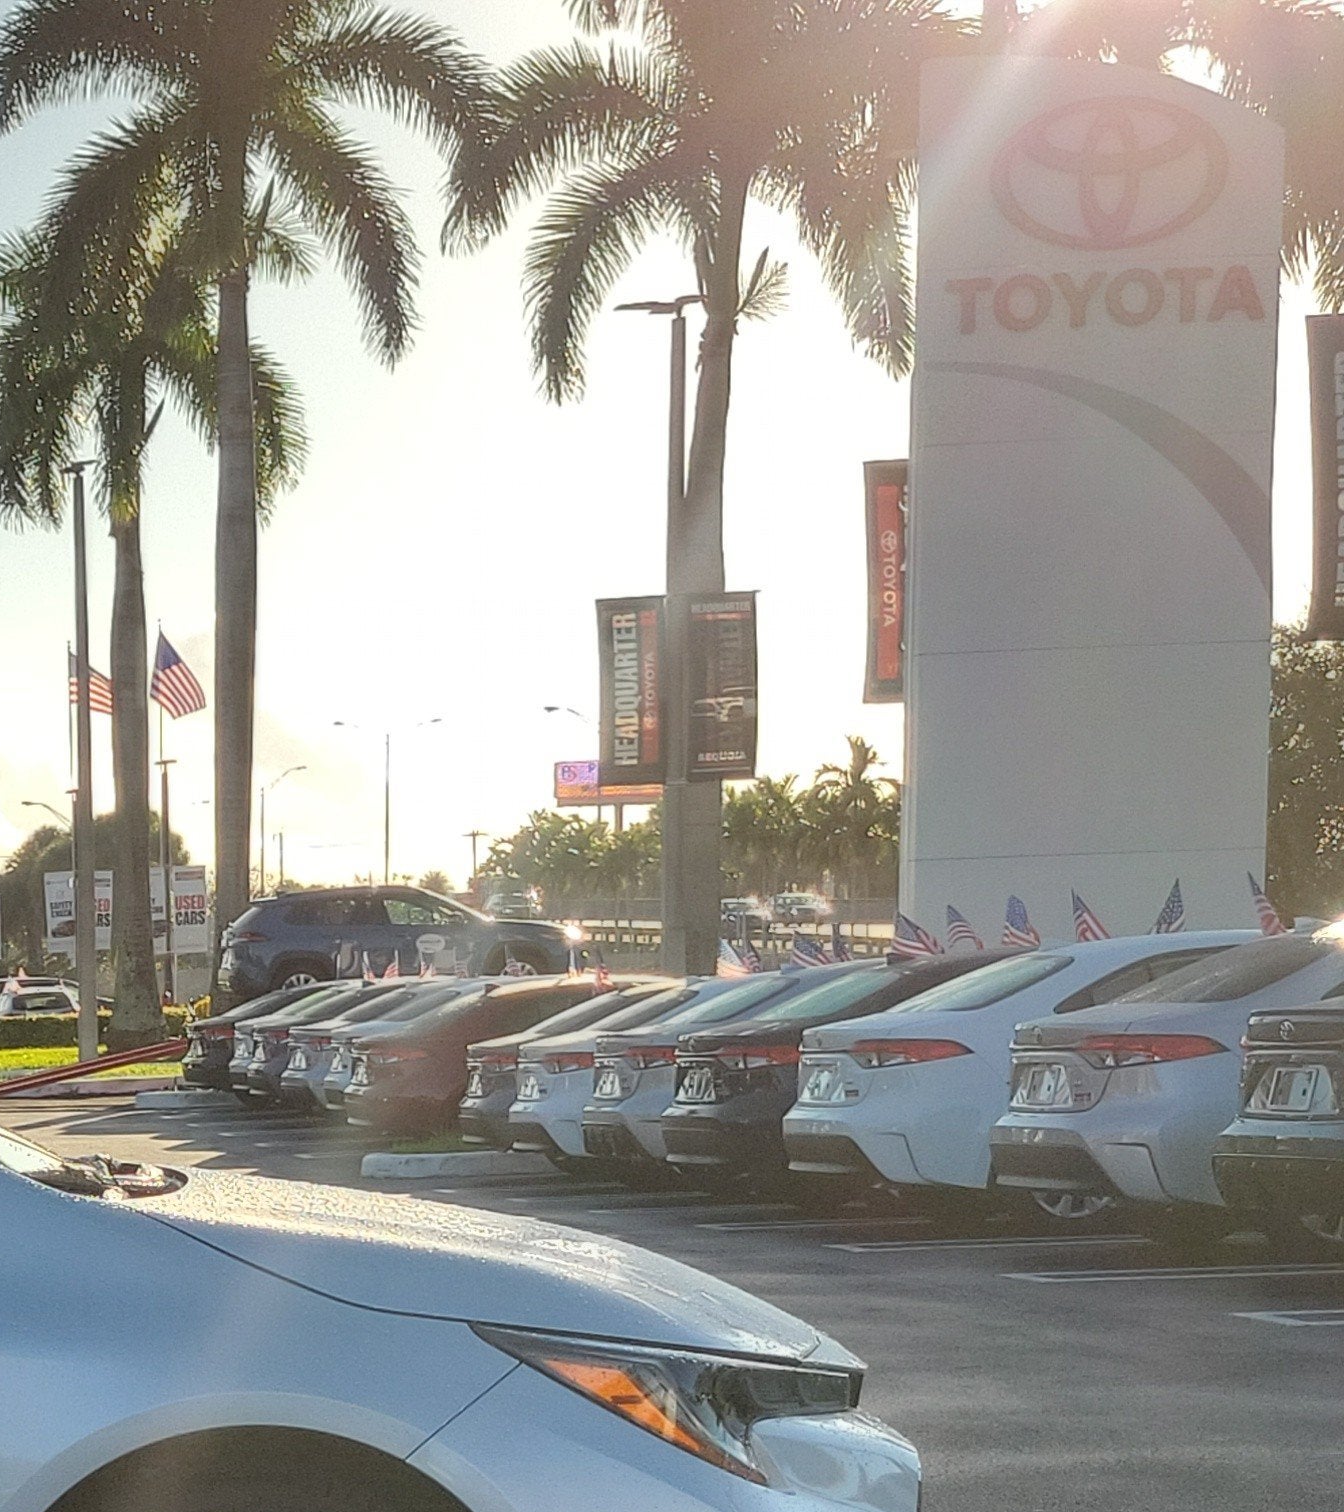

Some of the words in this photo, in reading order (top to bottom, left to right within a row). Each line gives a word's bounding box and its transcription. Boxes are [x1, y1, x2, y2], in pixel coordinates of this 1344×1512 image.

[945, 264, 1266, 336] TOYOTA
[883, 556, 898, 627] TOYOTA
[612, 612, 642, 767] HEADQUARTER
[643, 651, 656, 712] TOYOTA
[97, 898, 111, 912] ED
[97, 913, 111, 927] RS
[175, 894, 206, 910] USED
[175, 910, 207, 926] CARS
